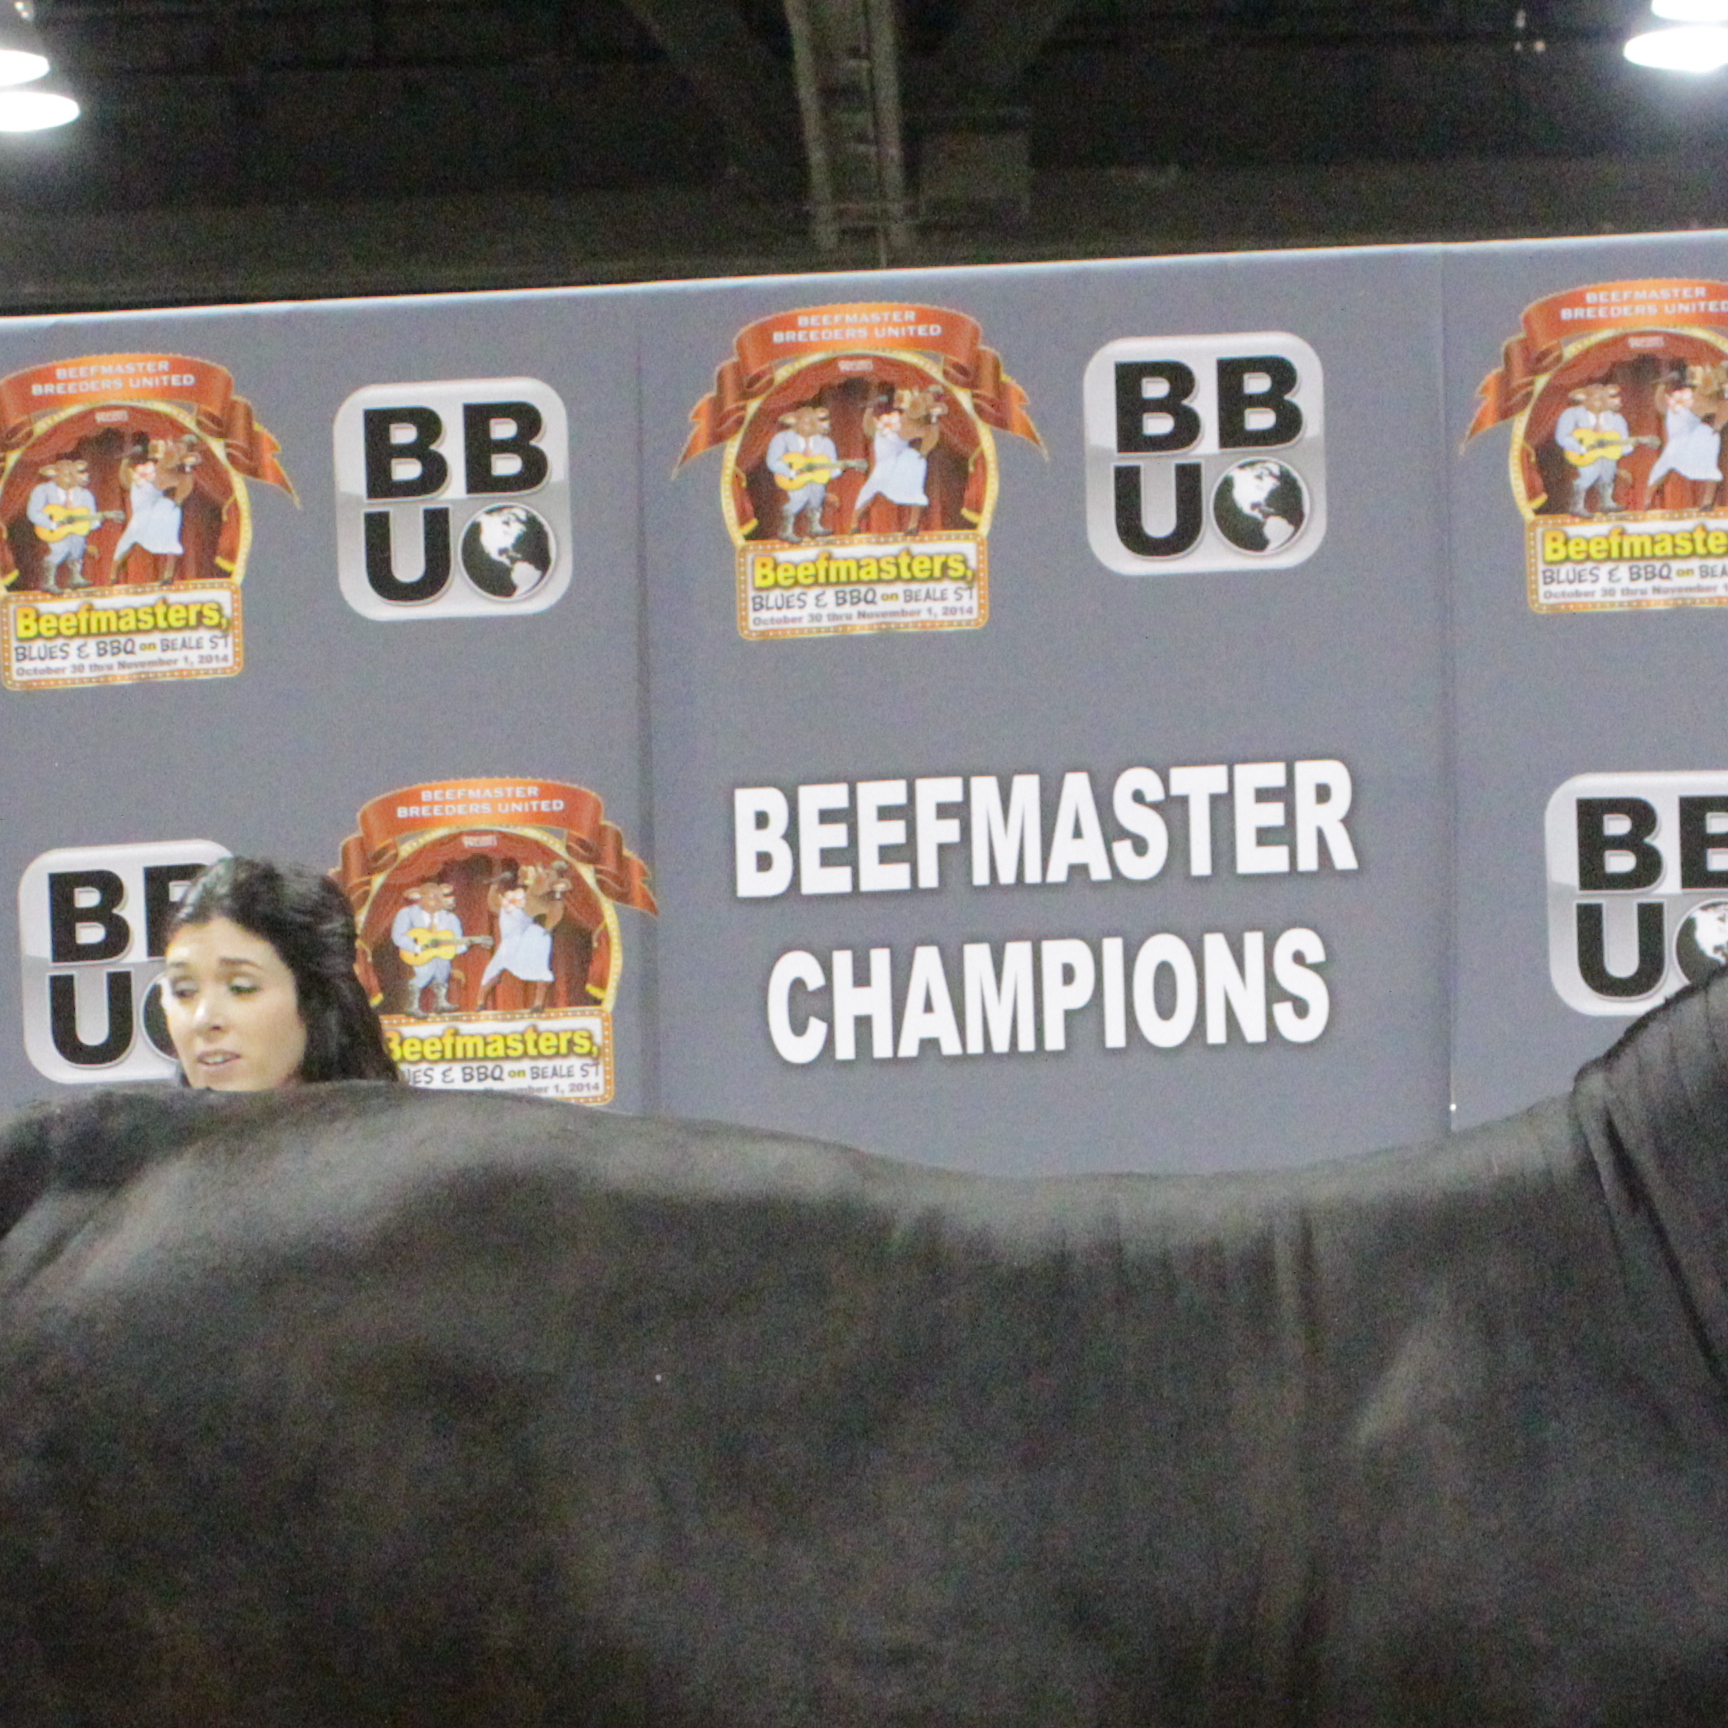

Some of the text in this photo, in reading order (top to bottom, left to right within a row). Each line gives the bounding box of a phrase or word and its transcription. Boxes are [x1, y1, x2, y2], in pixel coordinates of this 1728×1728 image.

[1585, 287, 1707, 304] BEEFMASTER
[797, 310, 916, 328] BEEFMASTER
[1560, 305, 1658, 321] BREEDERS
[773, 324, 942, 344] BREEDERS UNITED
[56, 361, 169, 380] BEEFMASTER
[31, 374, 195, 396] BREEDERS UNITED
[1115, 355, 1303, 453] BB
[363, 401, 548, 499] BB
[1114, 462, 1202, 556] U
[364, 507, 451, 602] U
[753, 547, 974, 588] Beefmasters,
[1542, 566, 1600, 585] BLUES
[1629, 563, 1672, 581] BBQ
[1675, 567, 1694, 577] on
[752, 592, 807, 611] BLUES
[835, 588, 877, 607] BBQ
[881, 592, 899, 601] on
[903, 587, 948, 603] BEALE
[953, 585, 974, 600] ST
[15, 597, 230, 641] Beefmasters,
[15, 643, 70, 662] BLUES
[96, 638, 136, 657] BBQ
[139, 641, 156, 652] on
[160, 636, 204, 652] BEALE
[209, 633, 229, 649] ST
[421, 786, 540, 802] BEEFMASTER
[397, 800, 565, 818] BREEDERS UNITED
[733, 758, 1359, 898] BEEFMASTER
[1576, 902, 1665, 997] U
[766, 927, 1330, 1064] CHAMPIONS
[462, 1064, 504, 1083] BBQ
[508, 1068, 526, 1078] on
[530, 1063, 574, 1080] BEALE
[580, 1062, 600, 1077] ST
